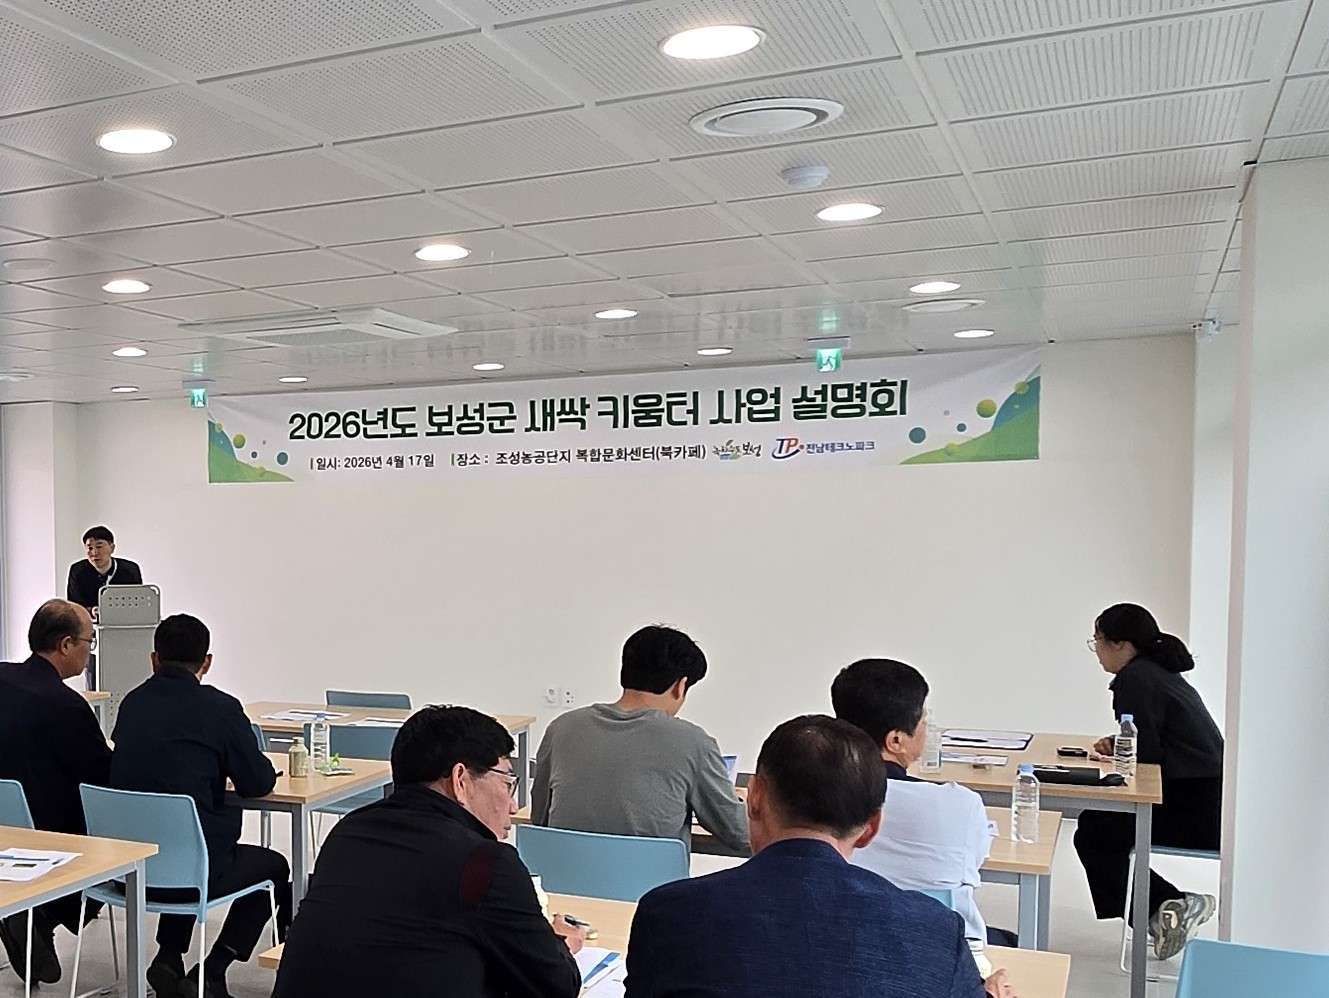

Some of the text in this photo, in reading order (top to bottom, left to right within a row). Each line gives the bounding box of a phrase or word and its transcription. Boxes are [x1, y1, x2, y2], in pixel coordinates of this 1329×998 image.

[288, 379, 908, 440] 2026년도 보성군 새싹 키움터 사업 설명회
[316, 457, 341, 471] 일시:
[343, 456, 383, 470] 2026년
[385, 455, 405, 469] 4월
[407, 454, 435, 468] 17일
[495, 449, 571, 465] 조성농공단지
[576, 444, 707, 463] 복합문화센터(북카페)
[805, 441, 875, 455] 전남테크노파크
